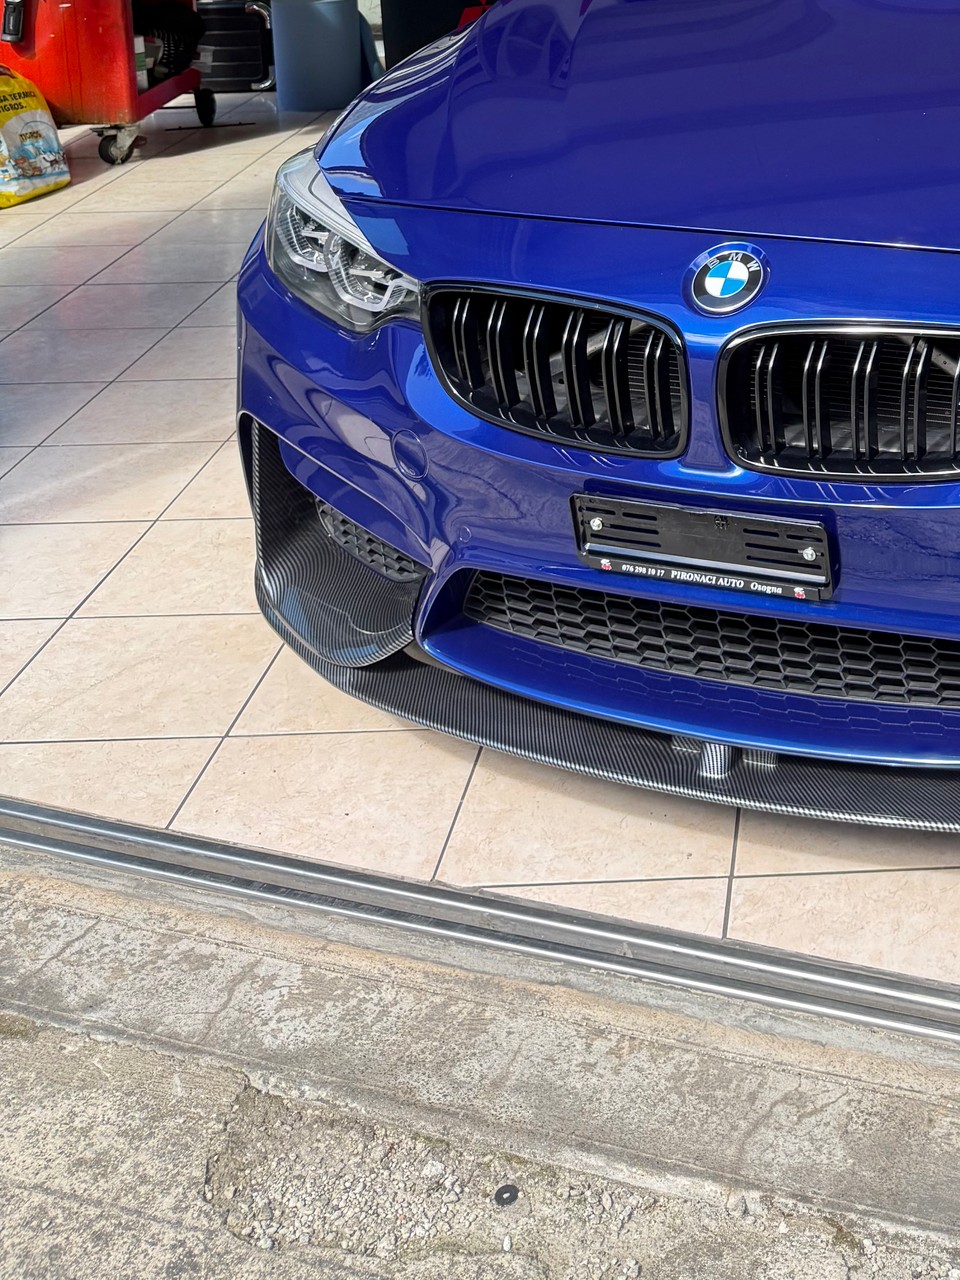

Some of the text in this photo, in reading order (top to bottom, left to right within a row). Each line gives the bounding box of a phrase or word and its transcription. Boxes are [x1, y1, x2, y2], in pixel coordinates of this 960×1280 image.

[707, 252, 761, 272] BMW
[622, 564, 782, 594] 076 298 10 17 PIRONACI AUTO Osogna
